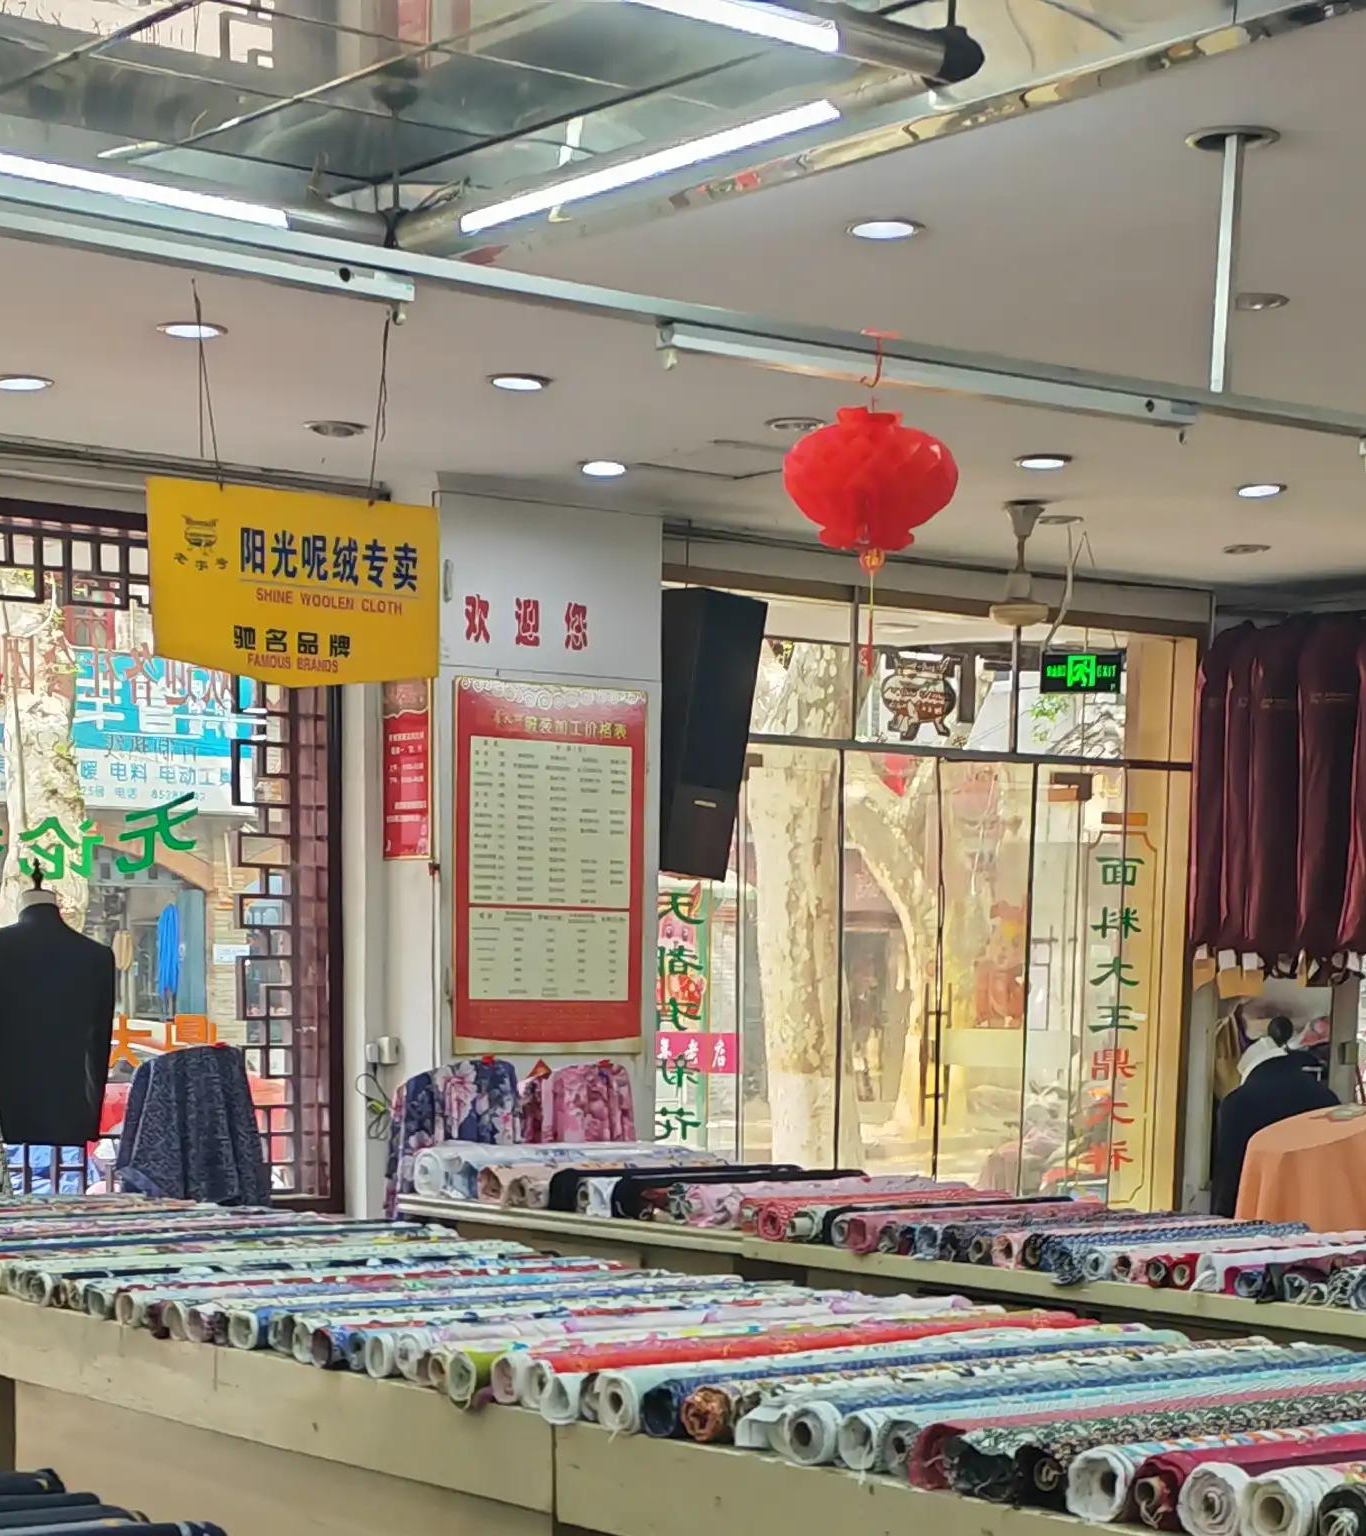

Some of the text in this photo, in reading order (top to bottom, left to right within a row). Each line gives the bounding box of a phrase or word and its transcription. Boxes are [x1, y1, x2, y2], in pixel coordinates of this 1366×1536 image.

[239, 525, 420, 593] 阳光呢绒专卖
[255, 586, 403, 617] SHINE WOOLEN CLOTH
[463, 593, 590, 651] 欢迎您
[232, 625, 352, 659] 驰名品牌
[246, 652, 340, 674] FAMOUS BRANDS
[1096, 664, 1118, 678] EXIT
